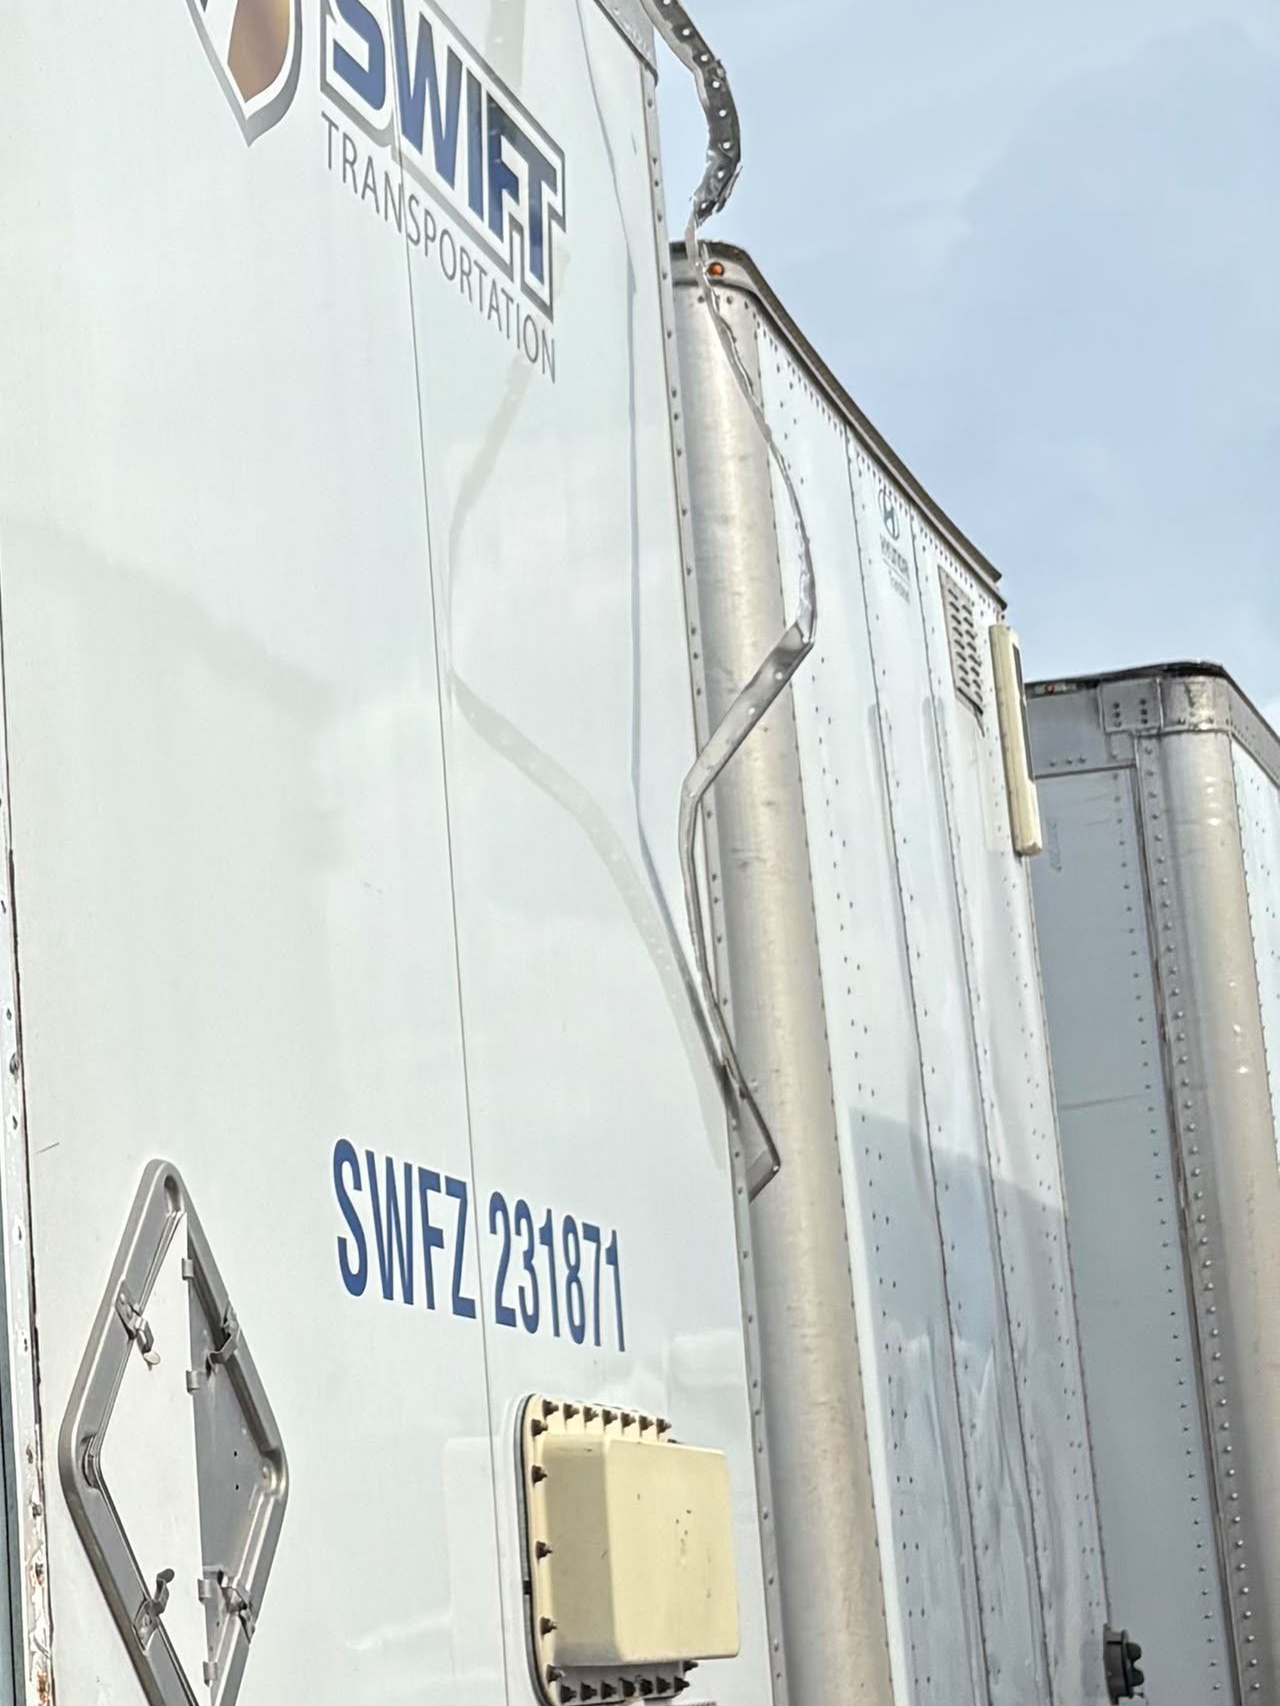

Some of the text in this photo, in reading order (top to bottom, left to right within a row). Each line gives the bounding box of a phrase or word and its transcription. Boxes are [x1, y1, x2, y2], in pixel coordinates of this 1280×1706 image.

[320, 110, 557, 384] TRANSPORTATION
[332, 1138, 626, 1353] SWFZ 231871
